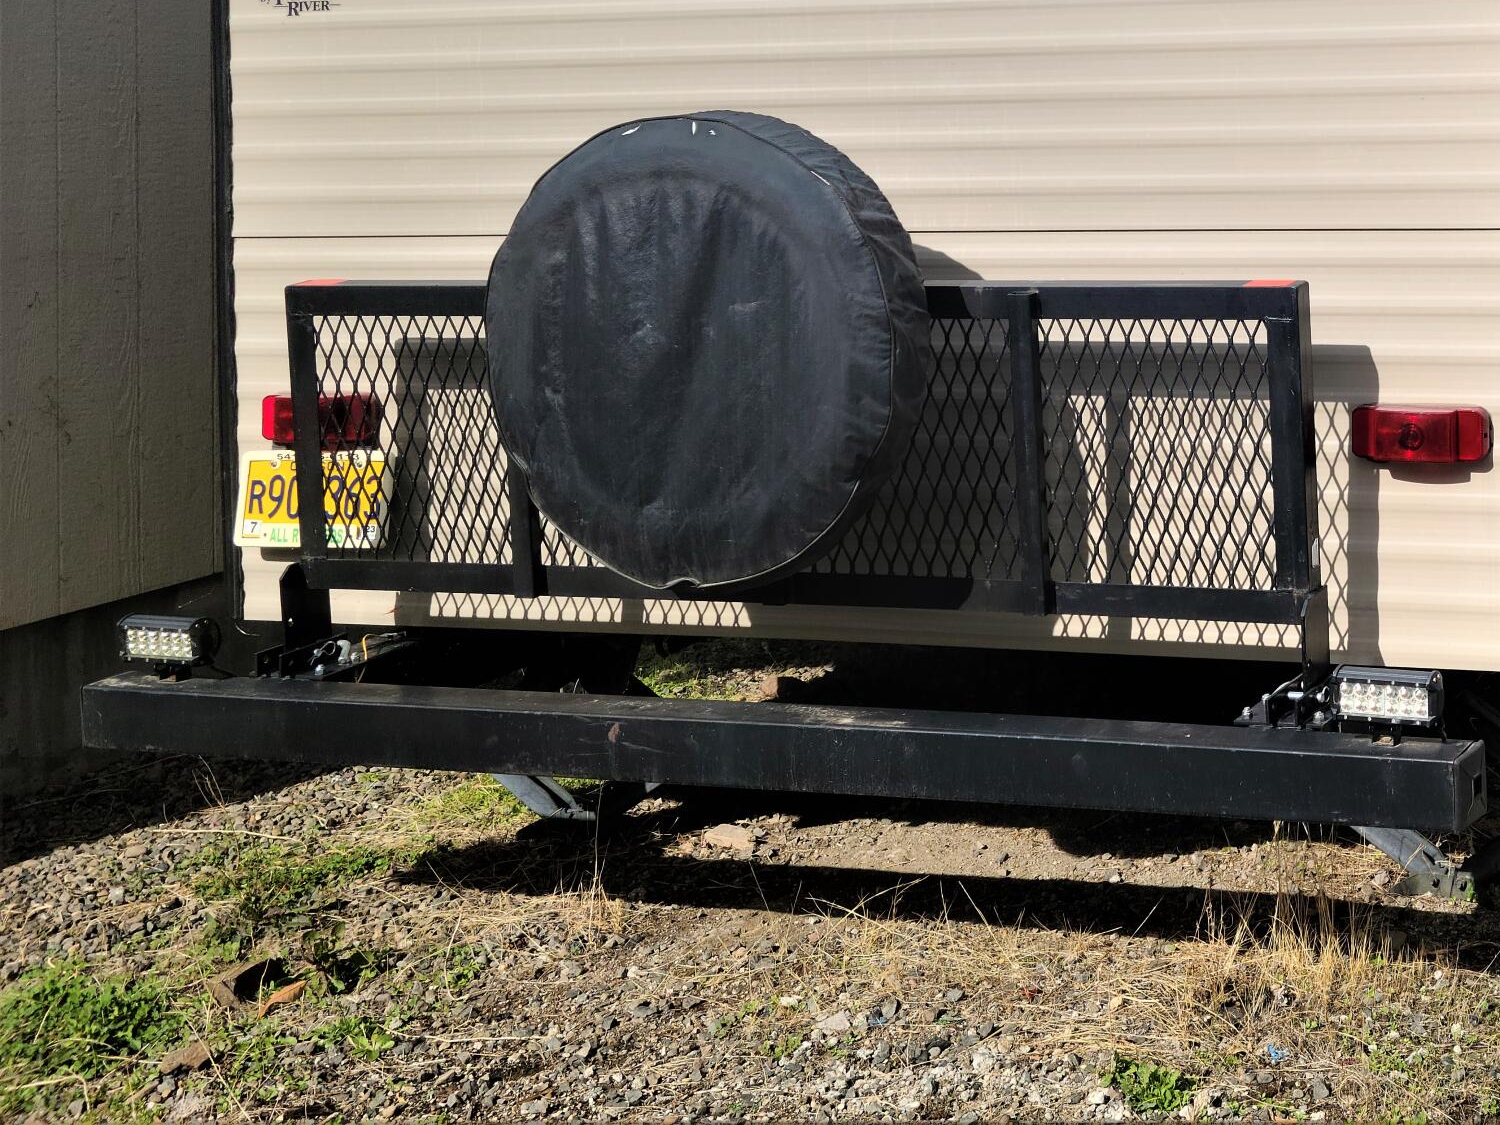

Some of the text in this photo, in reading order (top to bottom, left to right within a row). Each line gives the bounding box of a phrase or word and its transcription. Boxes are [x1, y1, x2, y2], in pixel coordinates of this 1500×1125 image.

[287, 0, 331, 16] RIVER
[248, 474, 381, 520] R90363
[250, 521, 258, 533] 7
[270, 528, 288, 542] ALL
